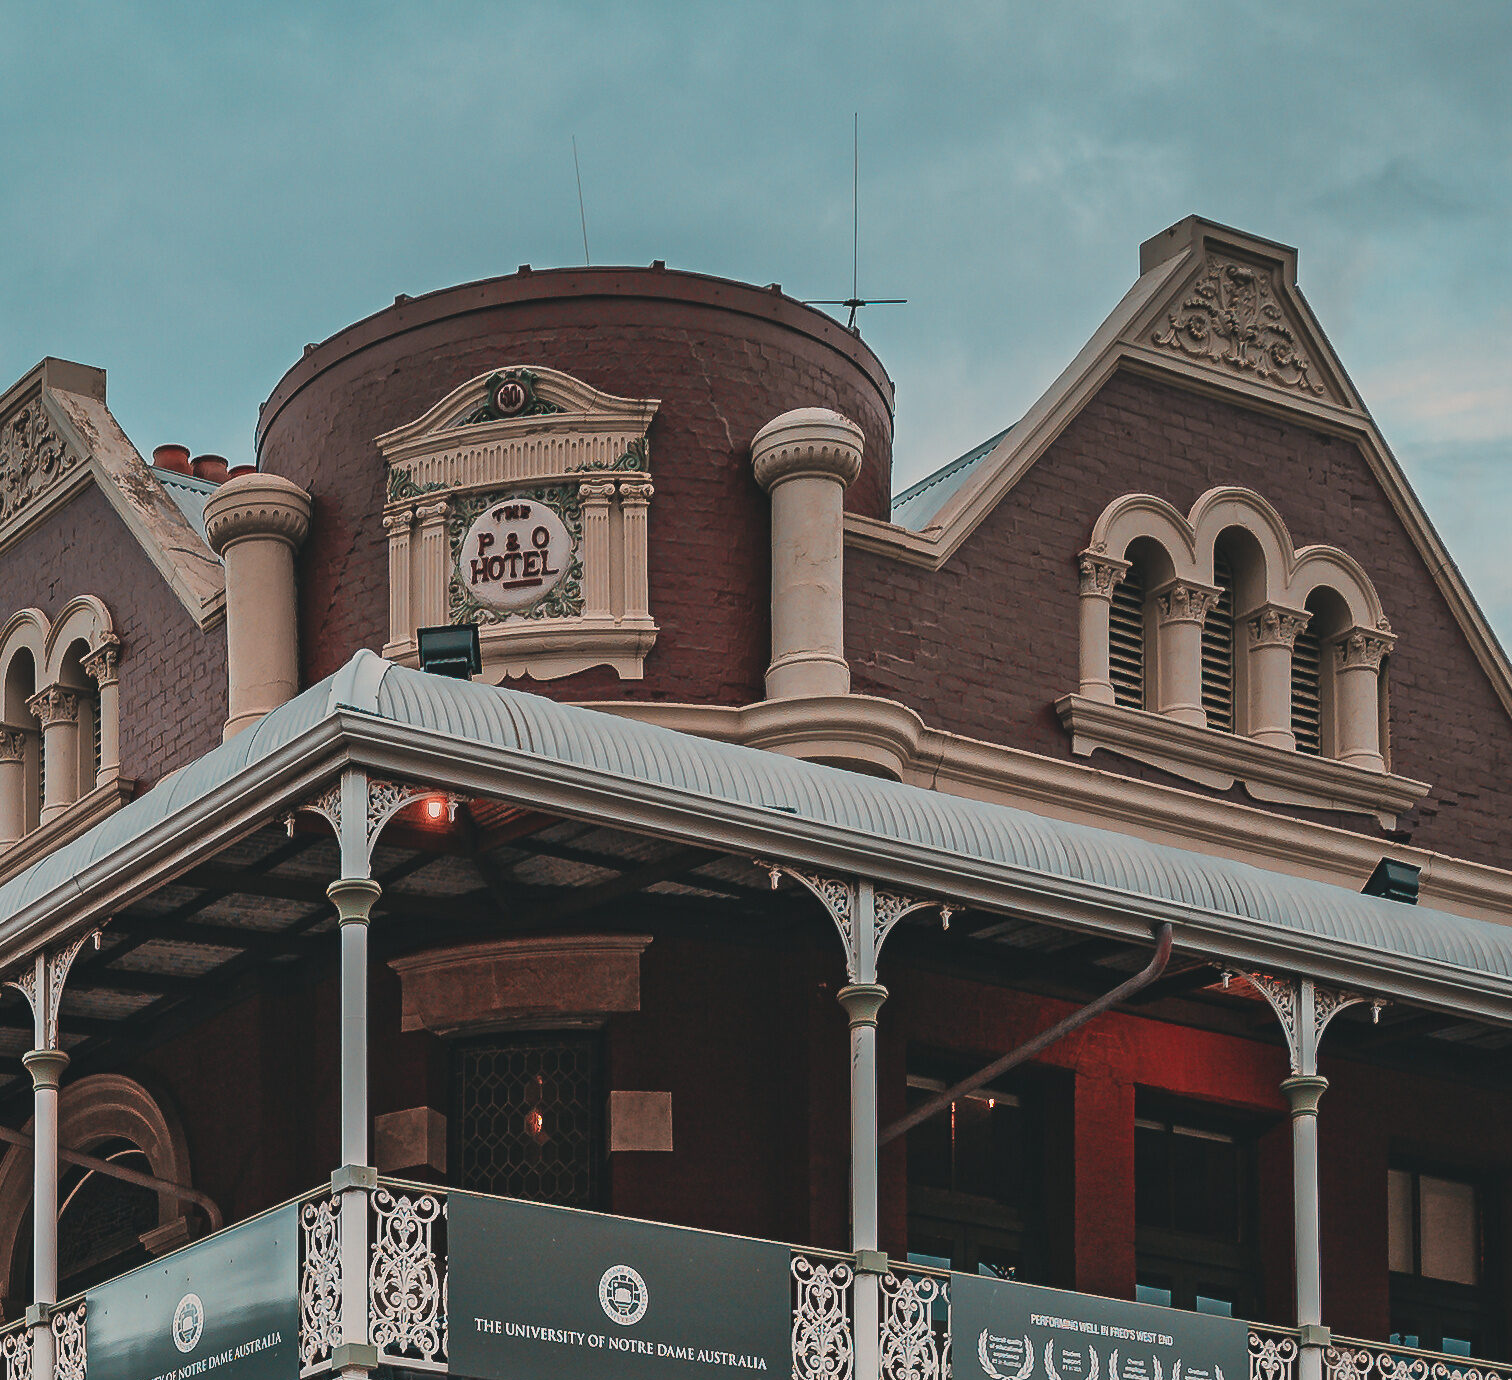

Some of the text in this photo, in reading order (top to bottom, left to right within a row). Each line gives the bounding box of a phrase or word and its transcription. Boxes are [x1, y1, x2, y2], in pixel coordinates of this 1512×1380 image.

[492, 505, 531, 523] THE
[478, 526, 550, 555] P & O
[470, 550, 559, 585] HOTEL
[474, 1317, 768, 1371] THE UNIVERSITY OF NOTRE DAME AUSTRALIA
[1030, 1313, 1079, 1331] PERFORMING
[1079, 1321, 1100, 1335] WELL
[1100, 1325, 1109, 1337] IN
[1136, 1330, 1157, 1344] WEST
[1158, 1334, 1174, 1346] END
[178, 1359, 207, 1380] NOTRE
[208, 1349, 233, 1369] DAME
[234, 1331, 282, 1360] AUSTRALIA
